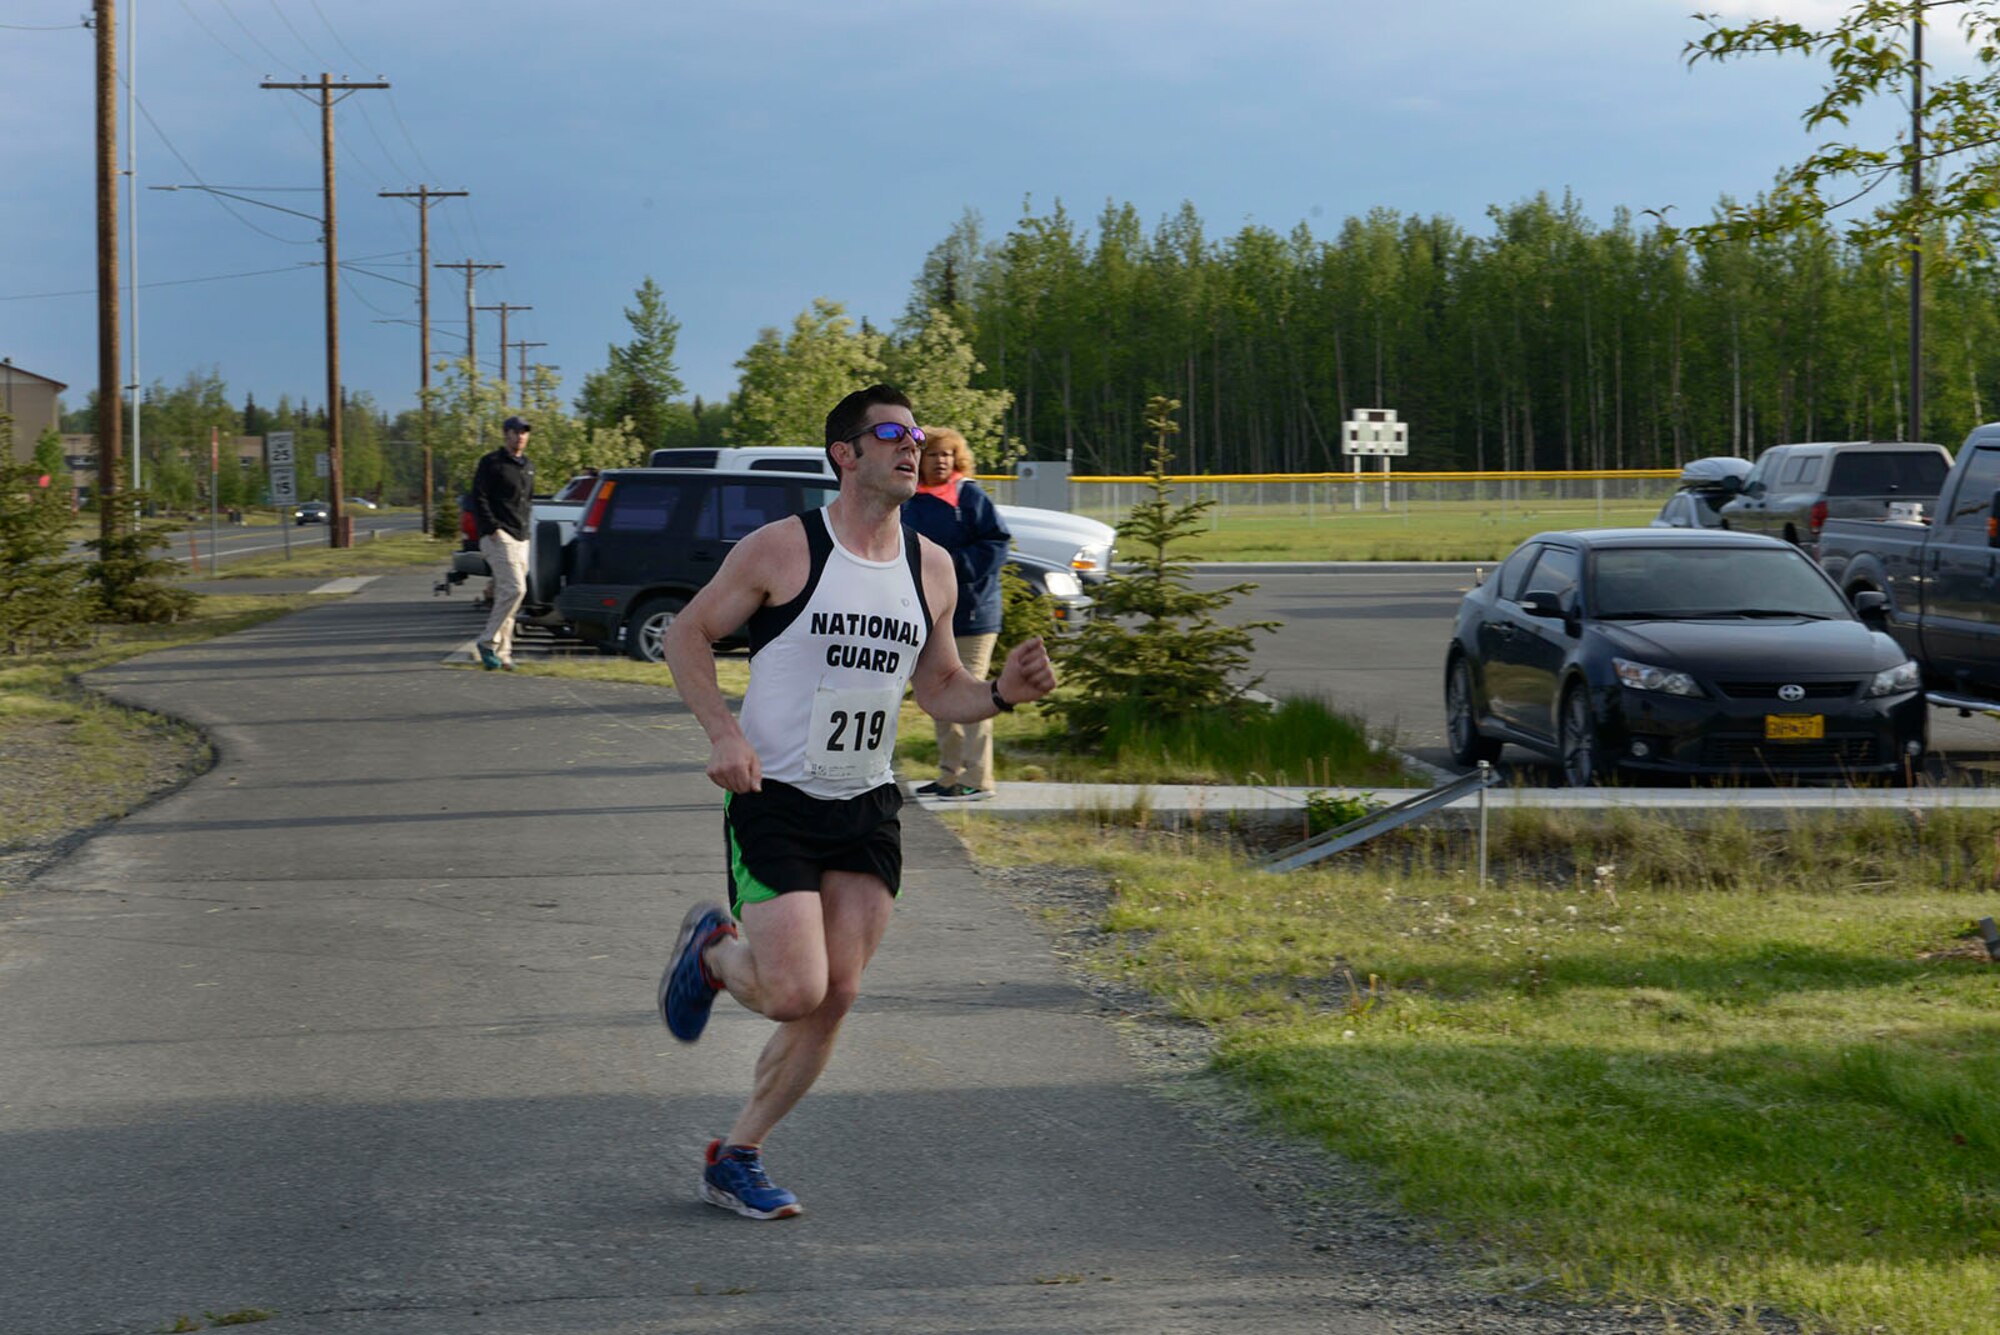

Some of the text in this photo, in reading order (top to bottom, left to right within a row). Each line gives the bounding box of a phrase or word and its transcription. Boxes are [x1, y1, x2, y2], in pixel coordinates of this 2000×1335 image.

[272, 449, 290, 461] 25
[275, 482, 292, 495] 15
[810, 612, 919, 647] NATIONAL
[826, 644, 900, 674] GUARD
[826, 710, 886, 751] 219
